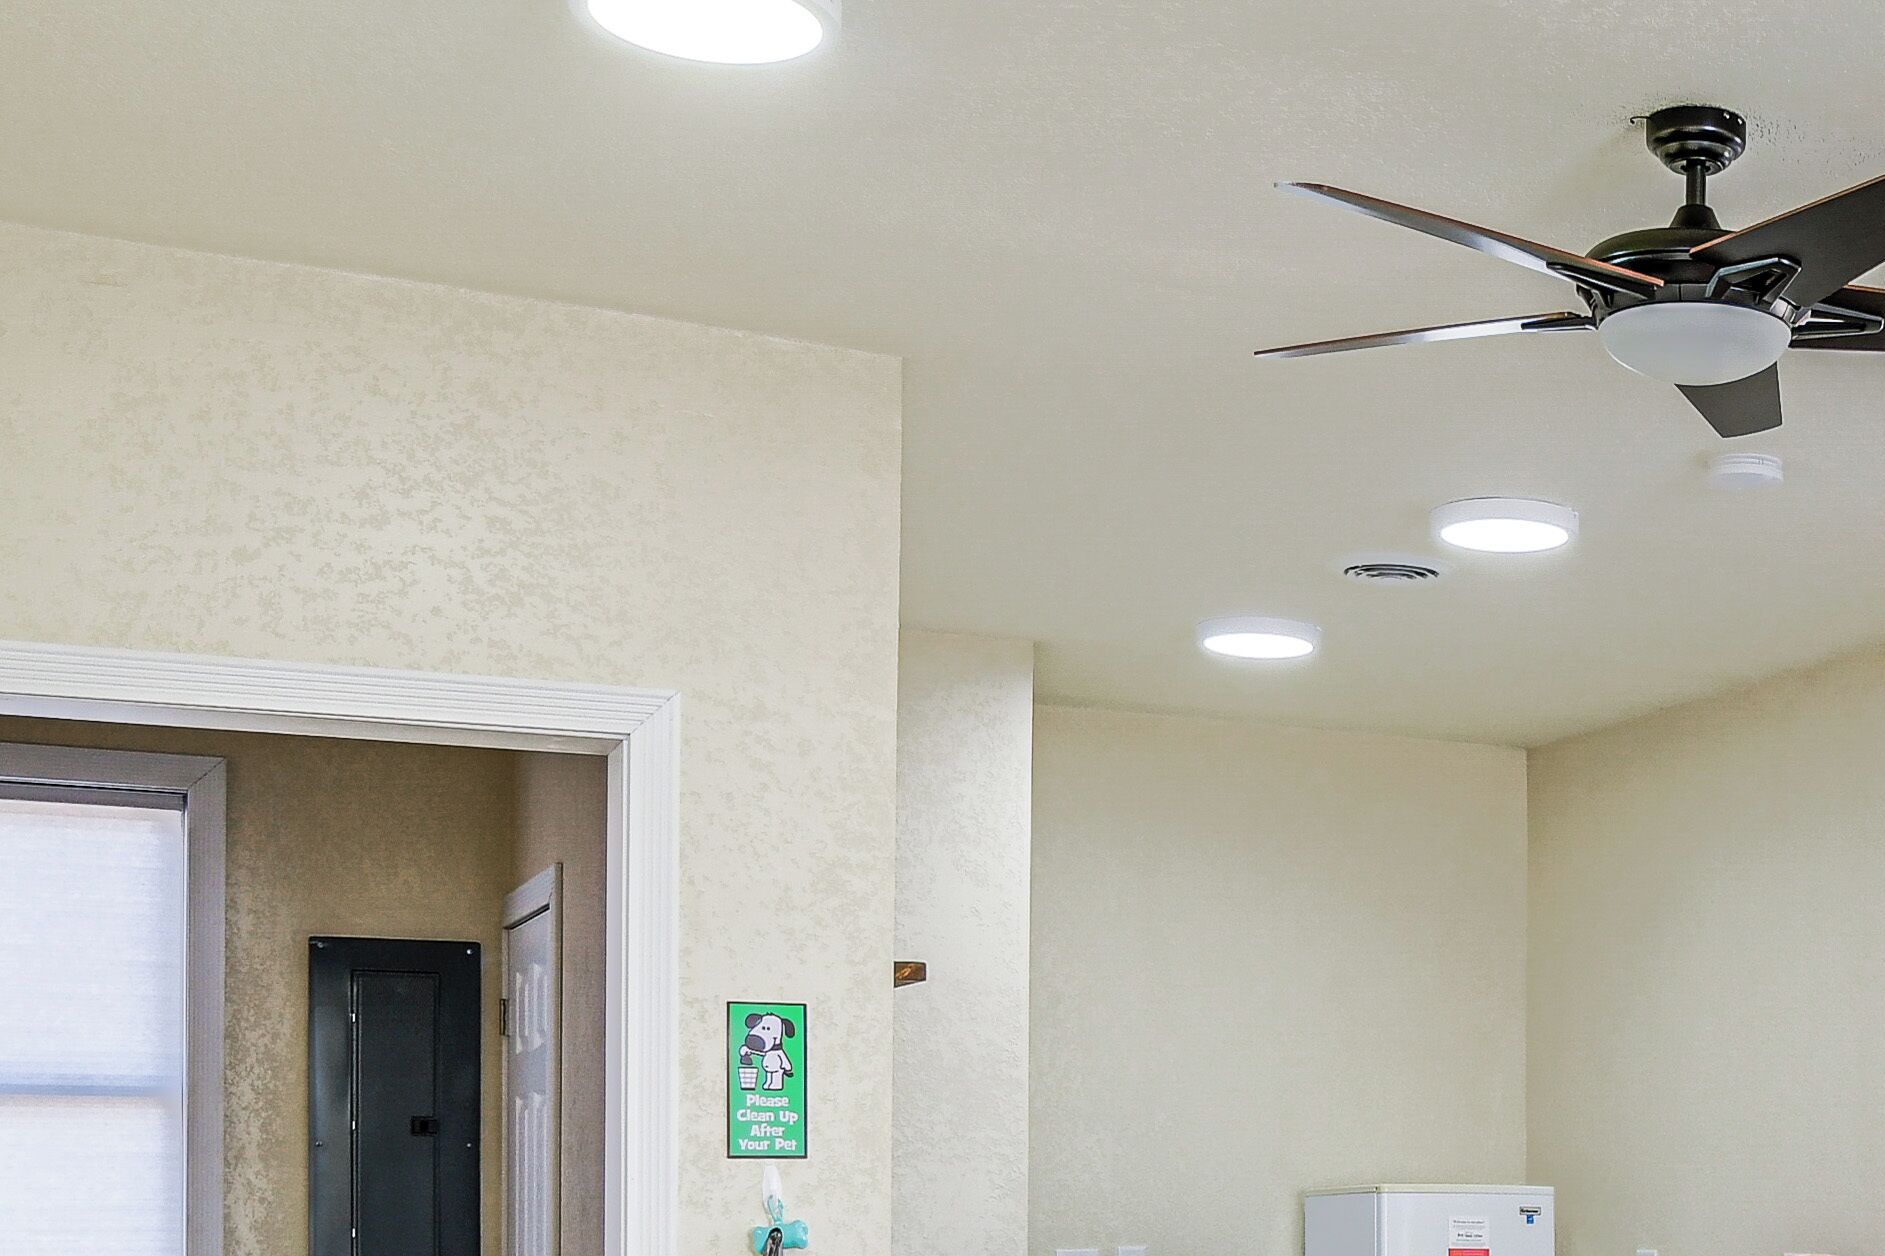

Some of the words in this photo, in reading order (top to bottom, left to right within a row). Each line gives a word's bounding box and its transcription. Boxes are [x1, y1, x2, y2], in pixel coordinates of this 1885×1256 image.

[746, 1094, 789, 1107] Please
[737, 1109, 774, 1121] Clean
[779, 1110, 798, 1125] Up
[750, 1123, 785, 1136] After
[738, 1139, 770, 1150] Your
[775, 1138, 797, 1150] Pet
